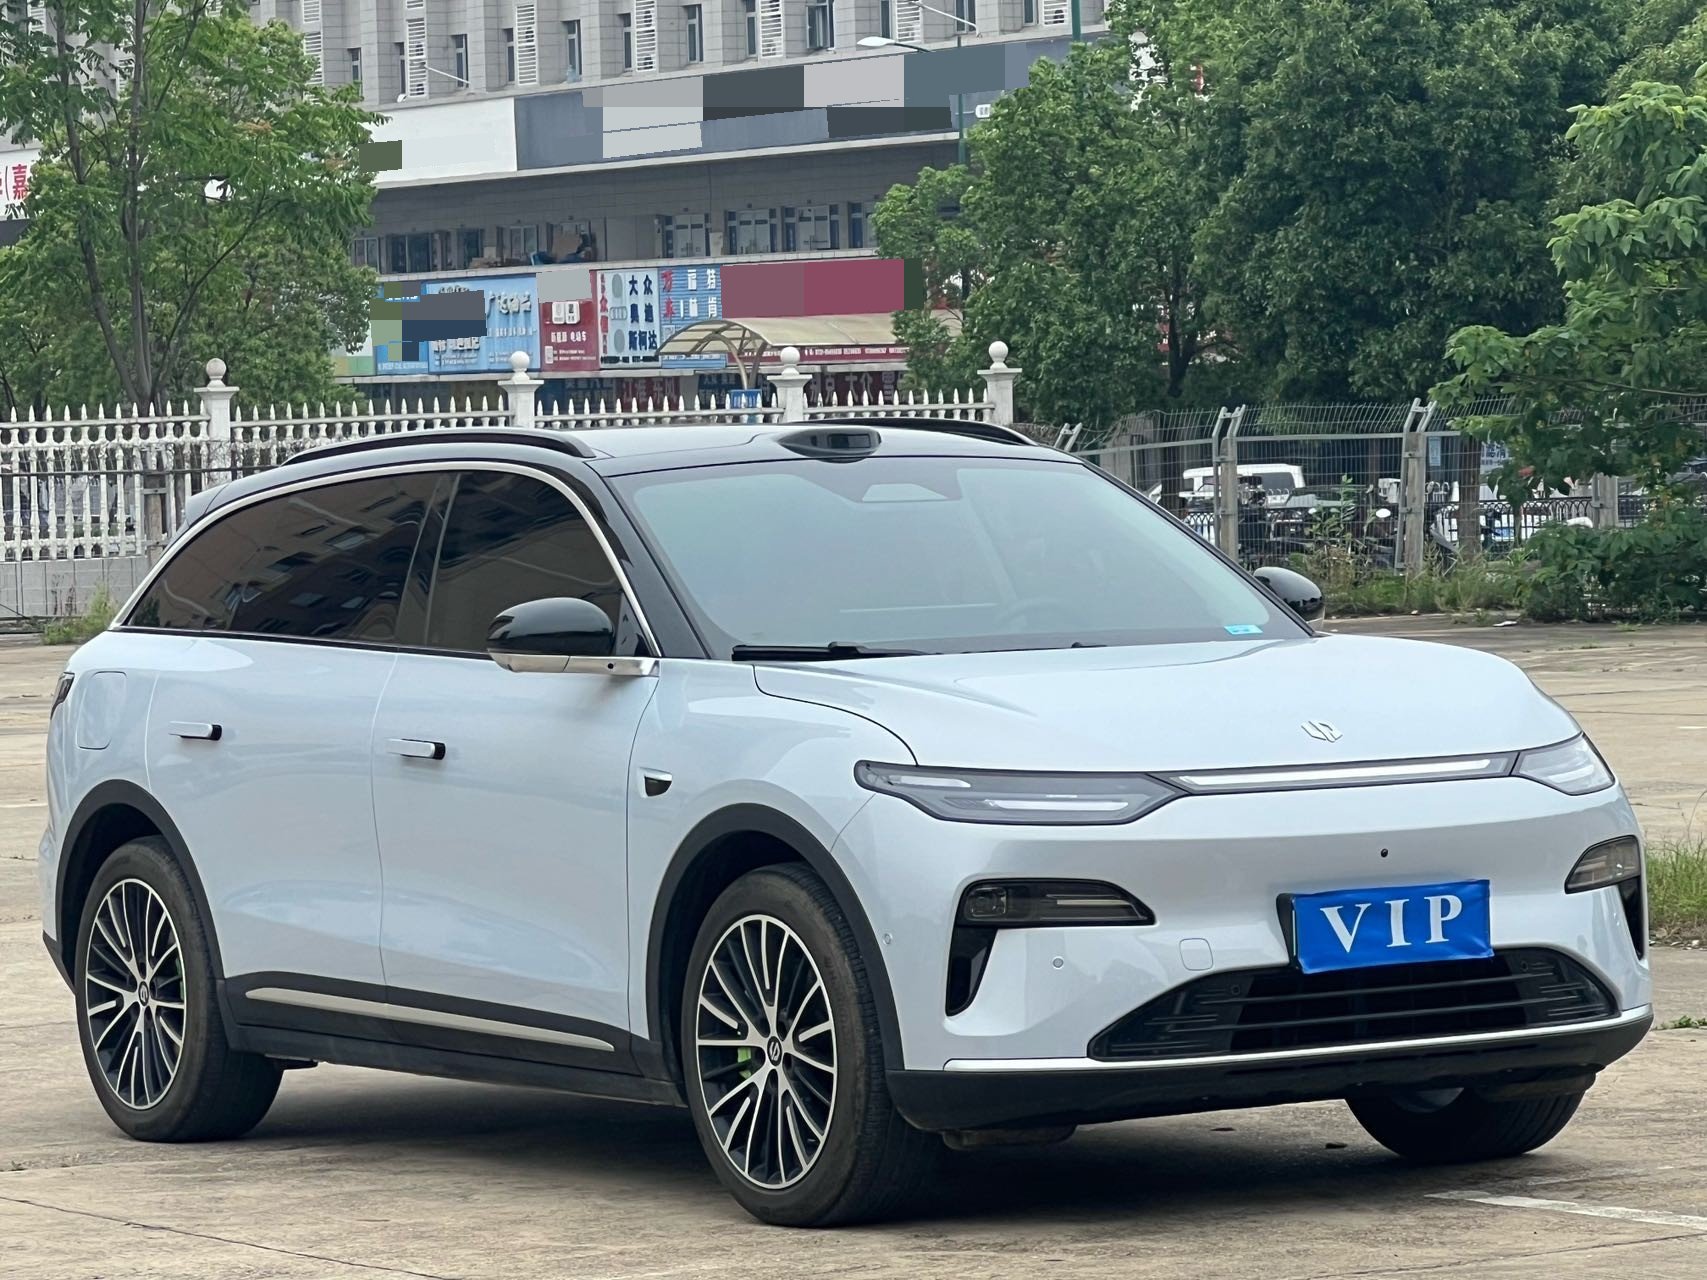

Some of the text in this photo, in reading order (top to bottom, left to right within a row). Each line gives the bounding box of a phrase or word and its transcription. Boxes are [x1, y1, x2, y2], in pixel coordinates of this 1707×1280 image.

[628, 274, 654, 296] 大众
[628, 329, 658, 351] 斯柯达
[1319, 894, 1463, 954] VIP
